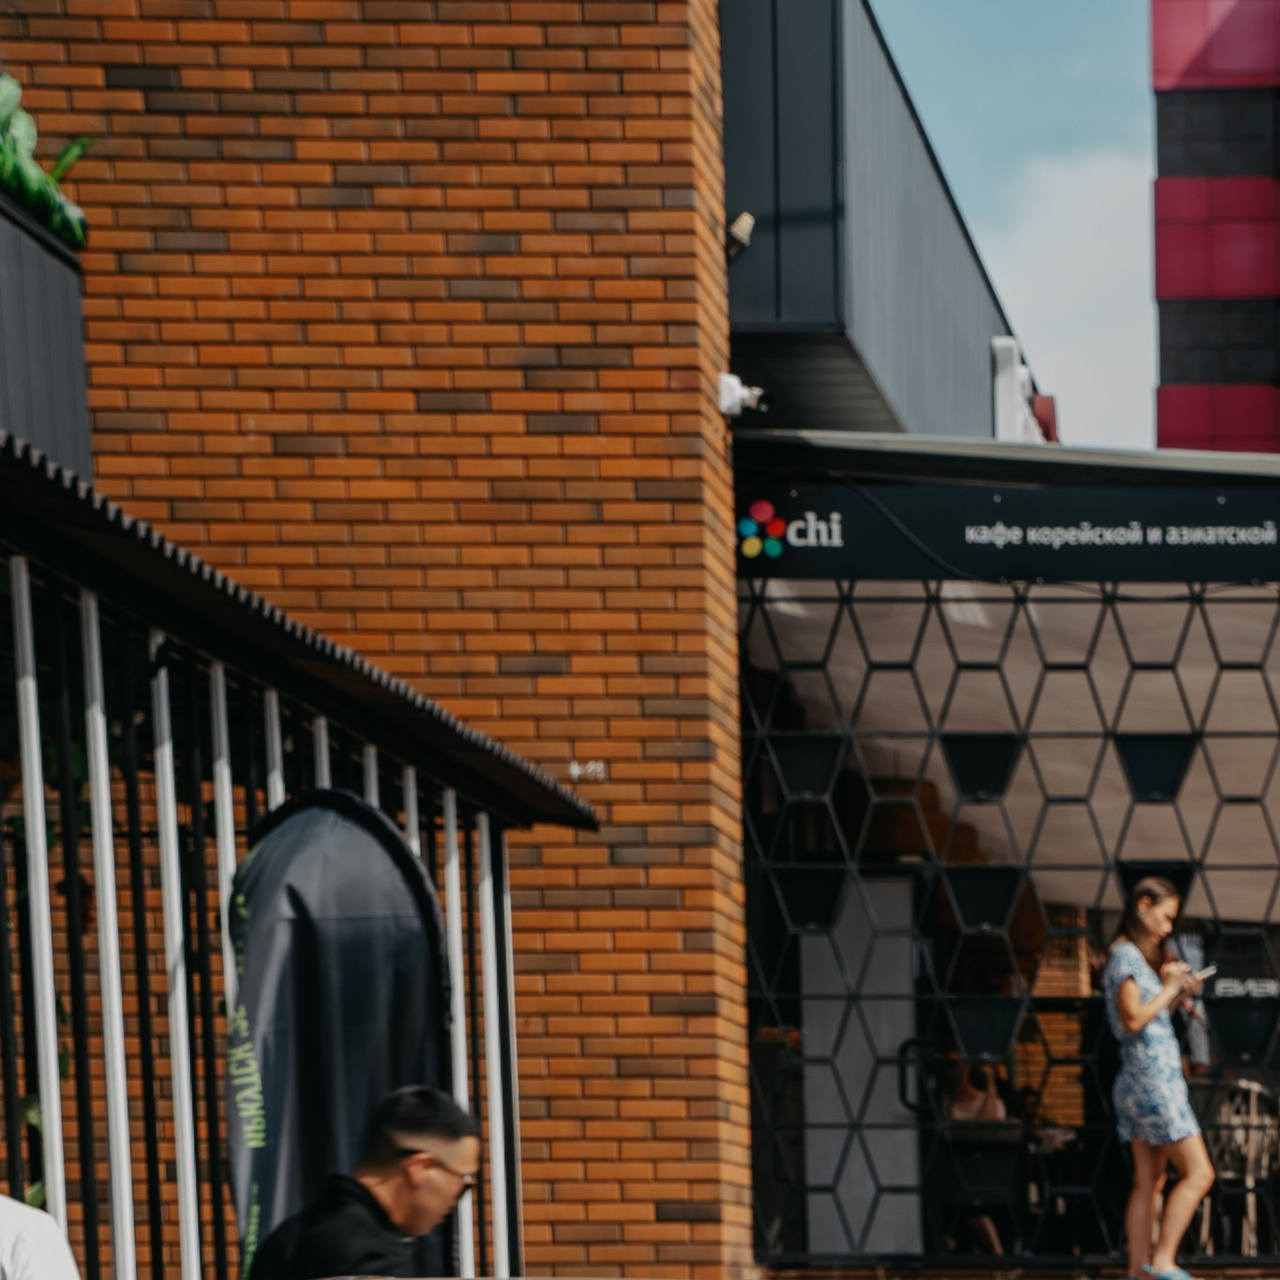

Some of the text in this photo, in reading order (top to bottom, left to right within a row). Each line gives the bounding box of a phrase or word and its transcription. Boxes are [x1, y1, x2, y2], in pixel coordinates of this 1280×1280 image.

[964, 521, 1024, 550] кафе
[1026, 521, 1143, 550] корейской
[1147, 526, 1163, 545] и
[1165, 520, 1277, 545] азиатской
